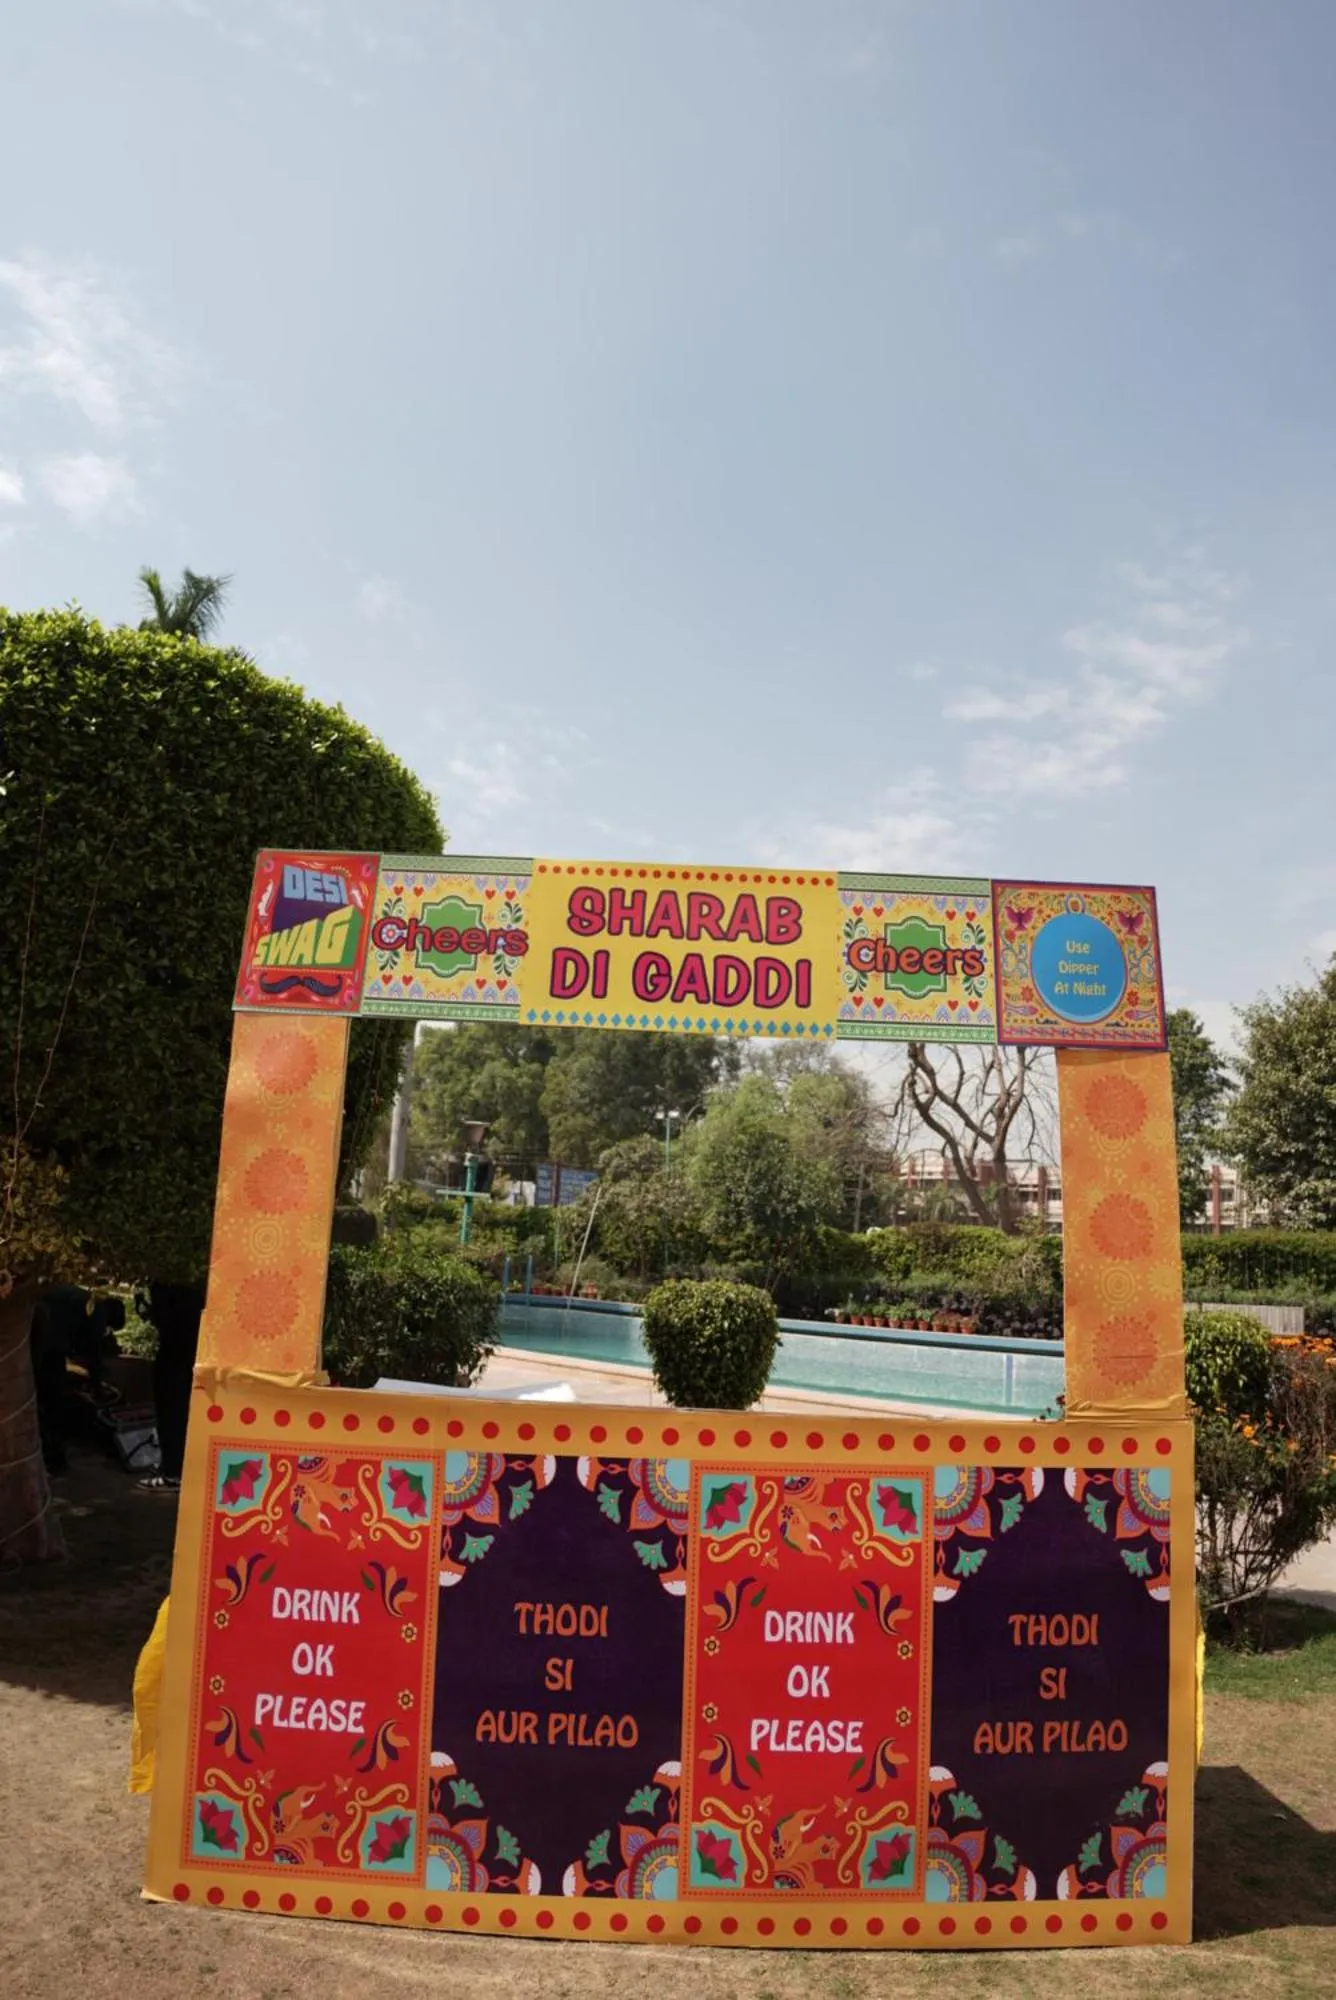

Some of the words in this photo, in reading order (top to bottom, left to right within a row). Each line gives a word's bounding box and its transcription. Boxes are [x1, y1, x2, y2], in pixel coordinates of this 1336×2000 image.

[284, 864, 348, 905] DESI
[567, 886, 802, 945] SHARAB
[252, 904, 355, 966] SWAG
[372, 917, 529, 957] Cheers
[1066, 940, 1090, 954] Use
[847, 937, 984, 976] Cheers
[549, 947, 610, 999] DI
[632, 951, 811, 1009] GADDI
[1054, 981, 1068, 994] At
[1073, 981, 1106, 997] Night
[272, 1587, 360, 1624] DRINK
[514, 1602, 609, 1637] THODI
[764, 1610, 854, 1644] DRINK
[1008, 1614, 1099, 1646] THODI
[292, 1643, 334, 1676] OK
[545, 1657, 573, 1692] SI
[787, 1665, 830, 1698] OK
[1039, 1667, 1067, 1699] SI
[255, 1693, 365, 1733] PLEASE
[476, 1710, 537, 1745] AUR
[548, 1713, 639, 1747] PILAO
[750, 1719, 863, 1754] PLEASE
[974, 1721, 1034, 1754] AUR
[1043, 1719, 1128, 1753] PILAO
